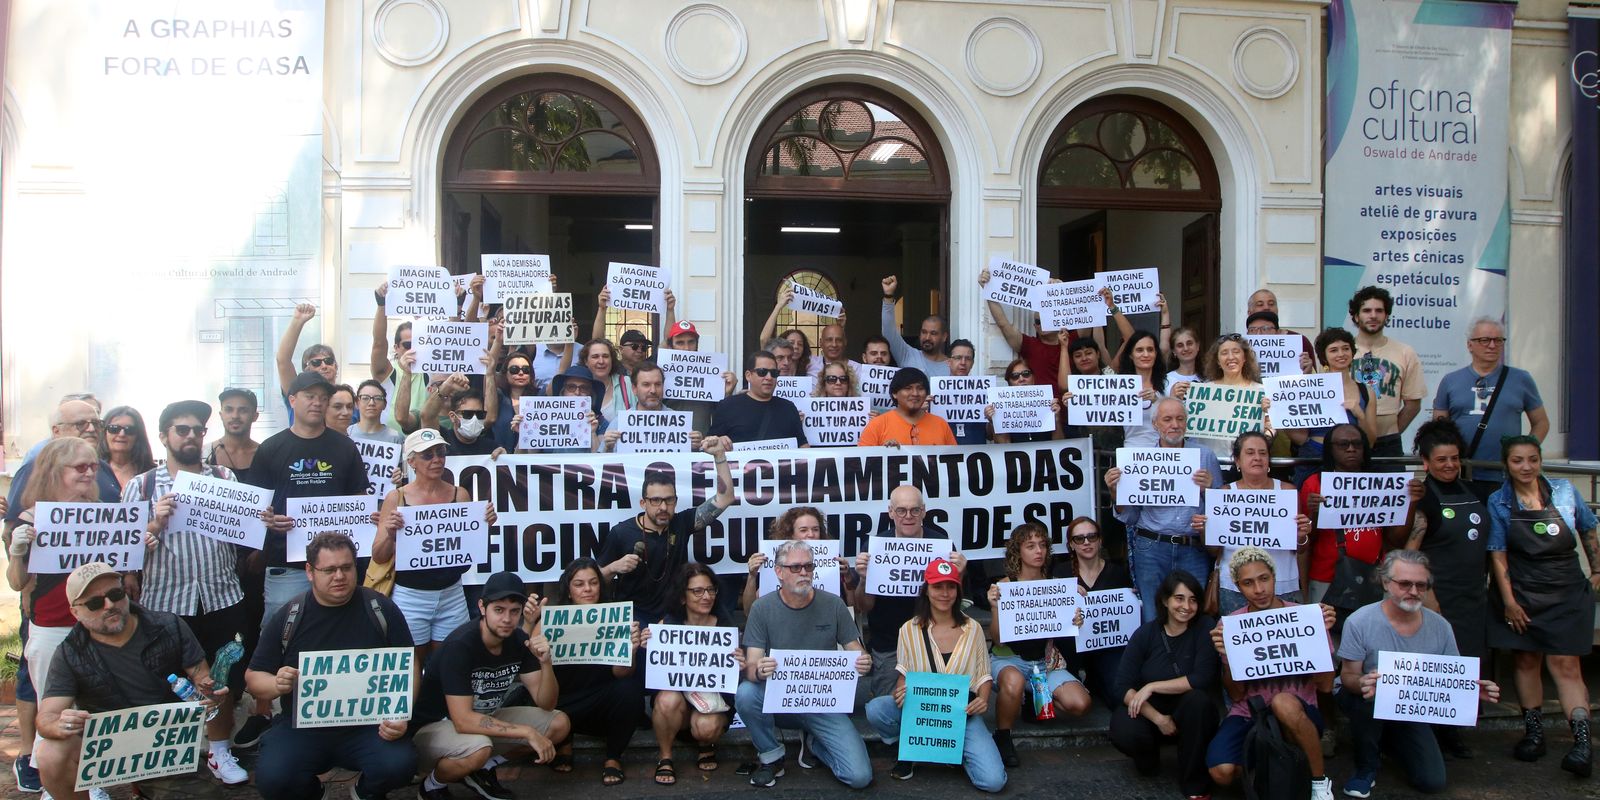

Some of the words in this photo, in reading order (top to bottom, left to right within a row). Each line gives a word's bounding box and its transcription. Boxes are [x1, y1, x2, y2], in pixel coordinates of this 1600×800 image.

[124, 20, 140, 38] A
[151, 19, 292, 38] GRAPHIAS
[105, 56, 180, 76] FORA
[192, 58, 226, 76] DE
[237, 56, 310, 75] CASA
[1369, 80, 1472, 113] oficina
[1363, 108, 1476, 144] cultural
[1364, 146, 1406, 159] Oswald
[1411, 148, 1424, 159] de
[1429, 148, 1477, 162] Andrade
[1375, 185, 1412, 196] artes
[1416, 185, 1463, 198] visuais
[1360, 205, 1399, 218] ateliê
[1404, 206, 1420, 218] de
[1425, 208, 1477, 222] gravura
[1381, 229, 1456, 244] exposições
[1373, 250, 1409, 262] artes
[1414, 250, 1464, 264] cênicas
[400, 269, 440, 278] IMAGINE
[621, 267, 657, 278] IMAGINE
[1377, 271, 1460, 286] espetáculos
[392, 279, 413, 288] SÃO
[417, 281, 450, 290] PAULO
[612, 276, 632, 285] SÃO
[634, 279, 664, 289] PAULO
[406, 292, 436, 303] SEM
[622, 288, 650, 300] SEM
[506, 296, 570, 310] OFICINAS
[614, 300, 657, 312] CULTURA
[1391, 294, 1457, 308] diovisual
[396, 306, 445, 315] CULTURA
[506, 311, 571, 324] CULTURAIS
[1384, 316, 1450, 329] cineclube
[428, 326, 471, 334] IMAGINE
[506, 325, 572, 339] VIVAS
[418, 336, 442, 345] SÃO
[445, 338, 480, 346] PAULO
[432, 349, 464, 360] SEM
[671, 354, 711, 363] IMAGINE
[422, 363, 474, 372] CULTURA
[663, 363, 684, 373] SÃO
[687, 366, 719, 375] PAULO
[674, 376, 704, 388] SEM
[939, 379, 990, 390] OFICINAS
[1078, 378, 1135, 389] OFICINAS
[1279, 378, 1324, 388] IMAGINE
[665, 389, 713, 400] CULTURA
[1071, 394, 1139, 406] CULTURAIS
[1189, 386, 1265, 404] IMAGINE
[1273, 391, 1296, 401] SÃO
[1299, 390, 1335, 400] PAULO
[534, 401, 575, 409] IMAGINE
[811, 400, 864, 412] OFICINAS
[1188, 402, 1206, 415] SP
[1232, 406, 1262, 420] SEM
[1288, 404, 1322, 416] SEM
[526, 411, 548, 421] SÃO
[551, 412, 584, 420] PAULO
[628, 414, 685, 426] OFICINAS
[805, 416, 867, 428] CULTURAIS
[1187, 417, 1260, 433] CULTURA
[1281, 418, 1336, 428] CULTURA
[539, 424, 570, 436] SEM
[530, 438, 579, 447] CULTURA
[620, 432, 687, 445] CULTURAIS
[1133, 453, 1180, 461] IMAGINE
[1124, 464, 1149, 474] SÃO
[1153, 466, 1192, 475] PAULO
[443, 462, 631, 512] ONTRA
[1004, 448, 1084, 494] DAS
[1139, 479, 1174, 491] SEM
[1333, 477, 1404, 490] OFICINAS
[1129, 494, 1185, 504] CULTURA
[1224, 494, 1276, 504] IMAGINE
[1323, 495, 1406, 508] CULTURAIS
[50, 507, 139, 524] OFICINAS
[416, 508, 468, 518] IMAGINE
[1214, 505, 1243, 516] SÃO
[1245, 508, 1288, 517] PAULO
[405, 524, 433, 536] SÃO
[438, 521, 479, 533] PAULO
[962, 506, 1012, 550] DE
[1230, 520, 1268, 534] SEM
[36, 530, 141, 547] CULTURAIS
[422, 537, 461, 553] SEM
[1218, 535, 1281, 547] CULTURA
[409, 553, 472, 569] CULTURA
[544, 606, 631, 625] IMAGINE
[1240, 612, 1299, 629] IMAGINE
[544, 626, 564, 642] SP
[596, 625, 630, 640] SEM
[659, 629, 732, 646] OFICINAS
[1232, 630, 1262, 645] SÃO
[1267, 626, 1315, 640] PAULO
[550, 642, 628, 660] ULTURA
[1254, 643, 1298, 661] SEM
[302, 652, 411, 676] IMAGINE
[650, 650, 735, 668] CULTURAIS
[784, 655, 800, 666] NÃO
[801, 655, 807, 666] À
[809, 656, 848, 667] DEMISSÃO
[1244, 660, 1316, 678] CULTURA
[1394, 658, 1412, 671] NÃO
[1414, 659, 1420, 671] À
[1422, 662, 1465, 674] DEMISSÃO
[771, 669, 787, 680] DOS
[790, 669, 855, 680] TRABALHADORES
[301, 679, 328, 698] SP
[367, 674, 408, 694] SEM
[786, 684, 796, 694] DA
[798, 682, 832, 694] CULTURA
[1382, 674, 1399, 685] DOS
[1402, 675, 1476, 690] TRABALHADORES
[782, 698, 792, 707] DE
[794, 696, 810, 707] SÃO
[812, 695, 836, 707] PAULO
[1399, 690, 1410, 700] DA
[1412, 691, 1450, 705] CULTURA
[301, 695, 408, 719] CULTURA
[1395, 704, 1406, 714] DE
[1408, 703, 1426, 716] SÃO
[1428, 706, 1456, 718] PAULO
[86, 706, 202, 738] IMAGINE
[83, 738, 113, 760] SP
[152, 725, 199, 748] SEM
[82, 746, 196, 782] CULTURA
